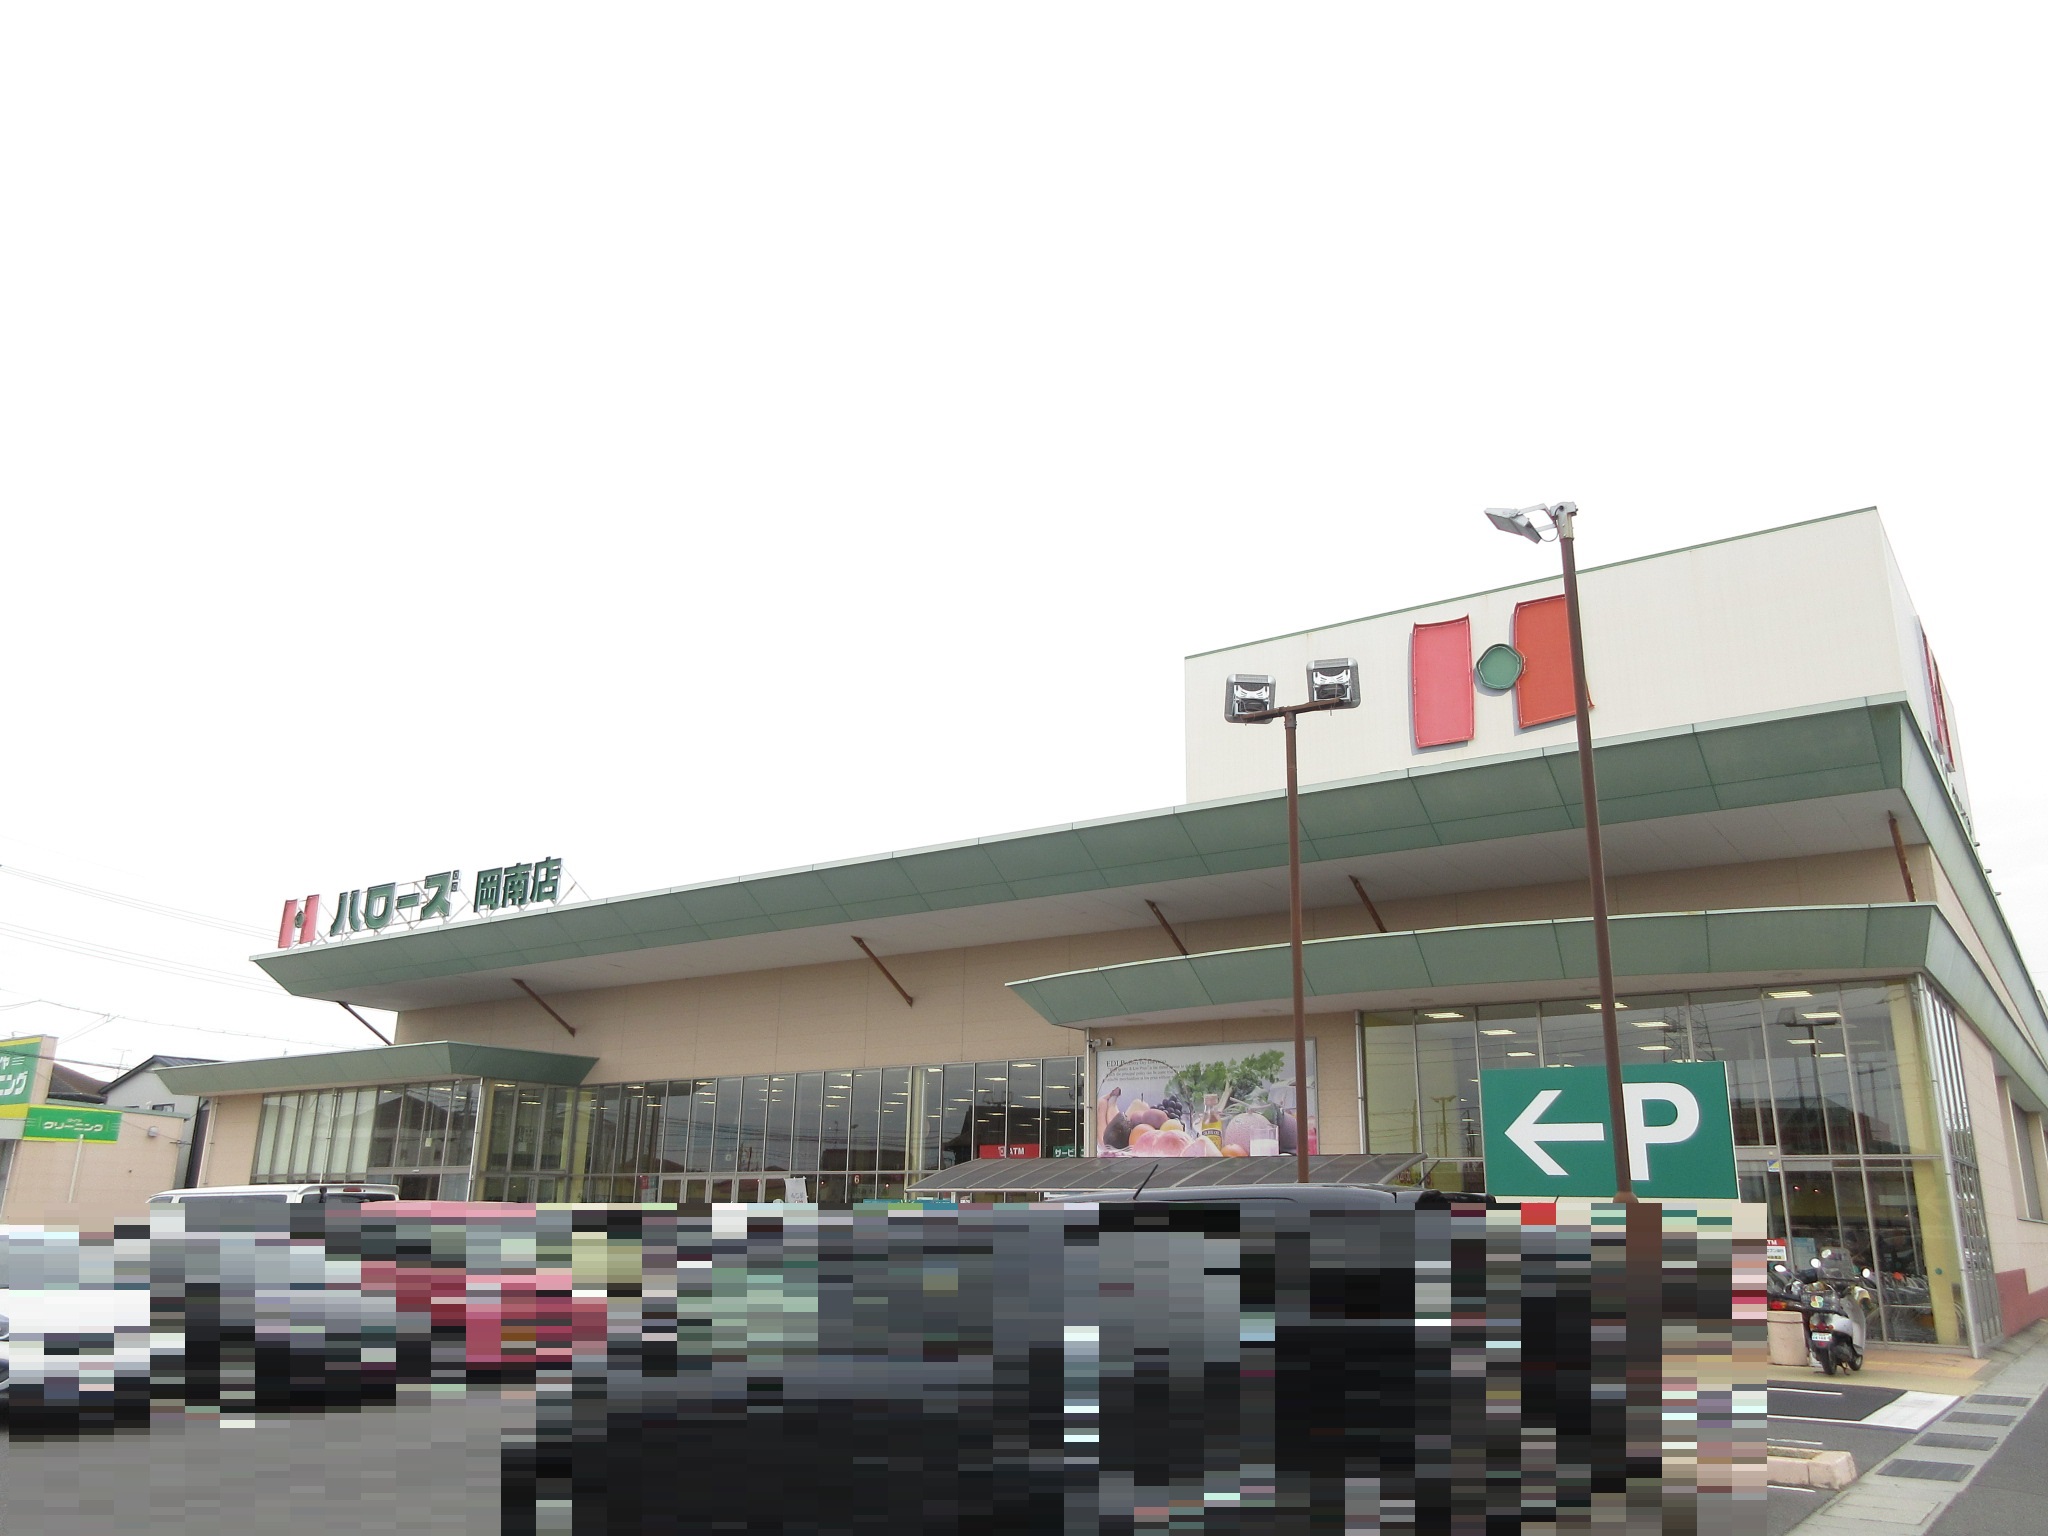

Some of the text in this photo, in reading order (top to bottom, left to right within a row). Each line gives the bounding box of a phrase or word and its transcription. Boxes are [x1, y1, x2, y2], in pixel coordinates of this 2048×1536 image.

[330, 870, 460, 937] ハローズ
[474, 856, 563, 913] 岡南店
[43, 1121, 103, 1132] クリーニング
[1622, 1082, 1700, 1181] P
